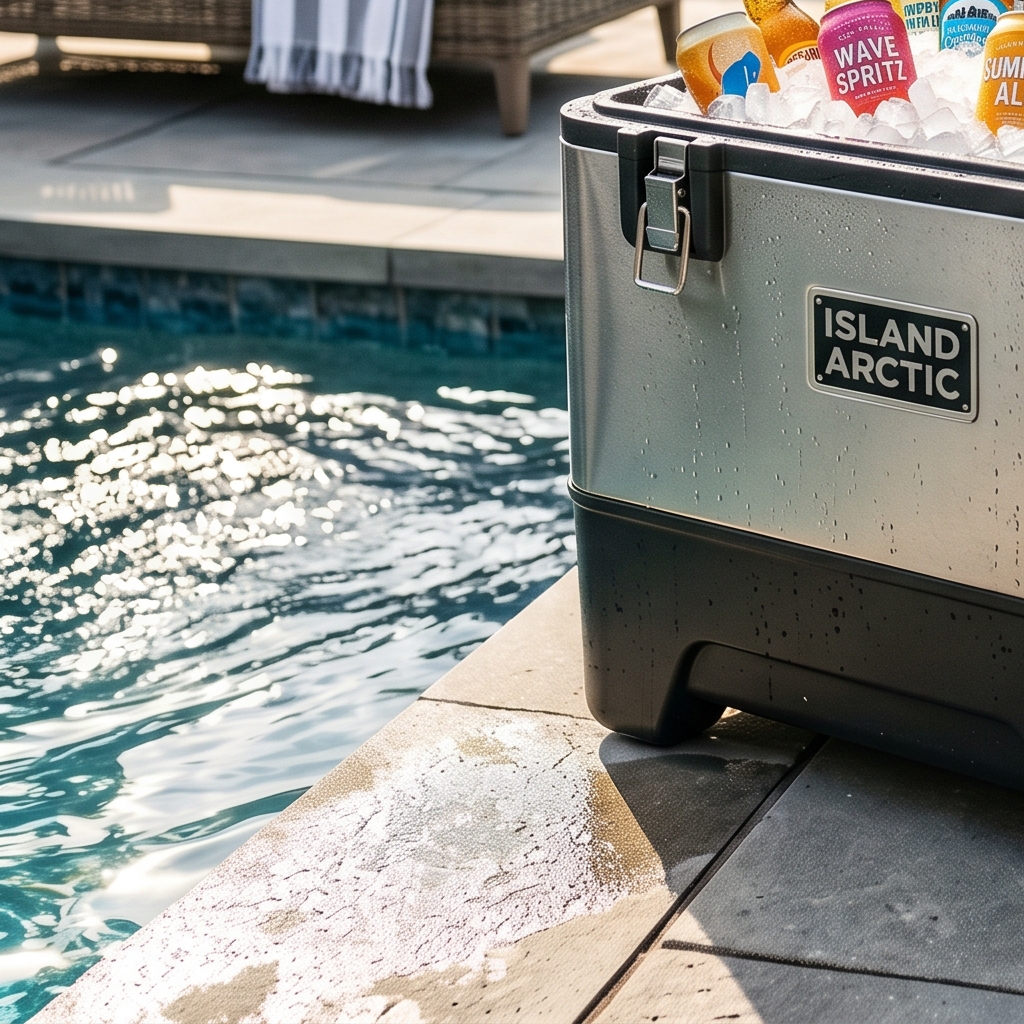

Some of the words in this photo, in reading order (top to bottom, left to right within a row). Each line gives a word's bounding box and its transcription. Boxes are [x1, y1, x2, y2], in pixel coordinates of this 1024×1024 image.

[833, 36, 899, 69] WAVE
[836, 60, 907, 95] SPRITZ
[824, 307, 960, 361] ISLAND
[824, 346, 960, 400] ARCTIC
